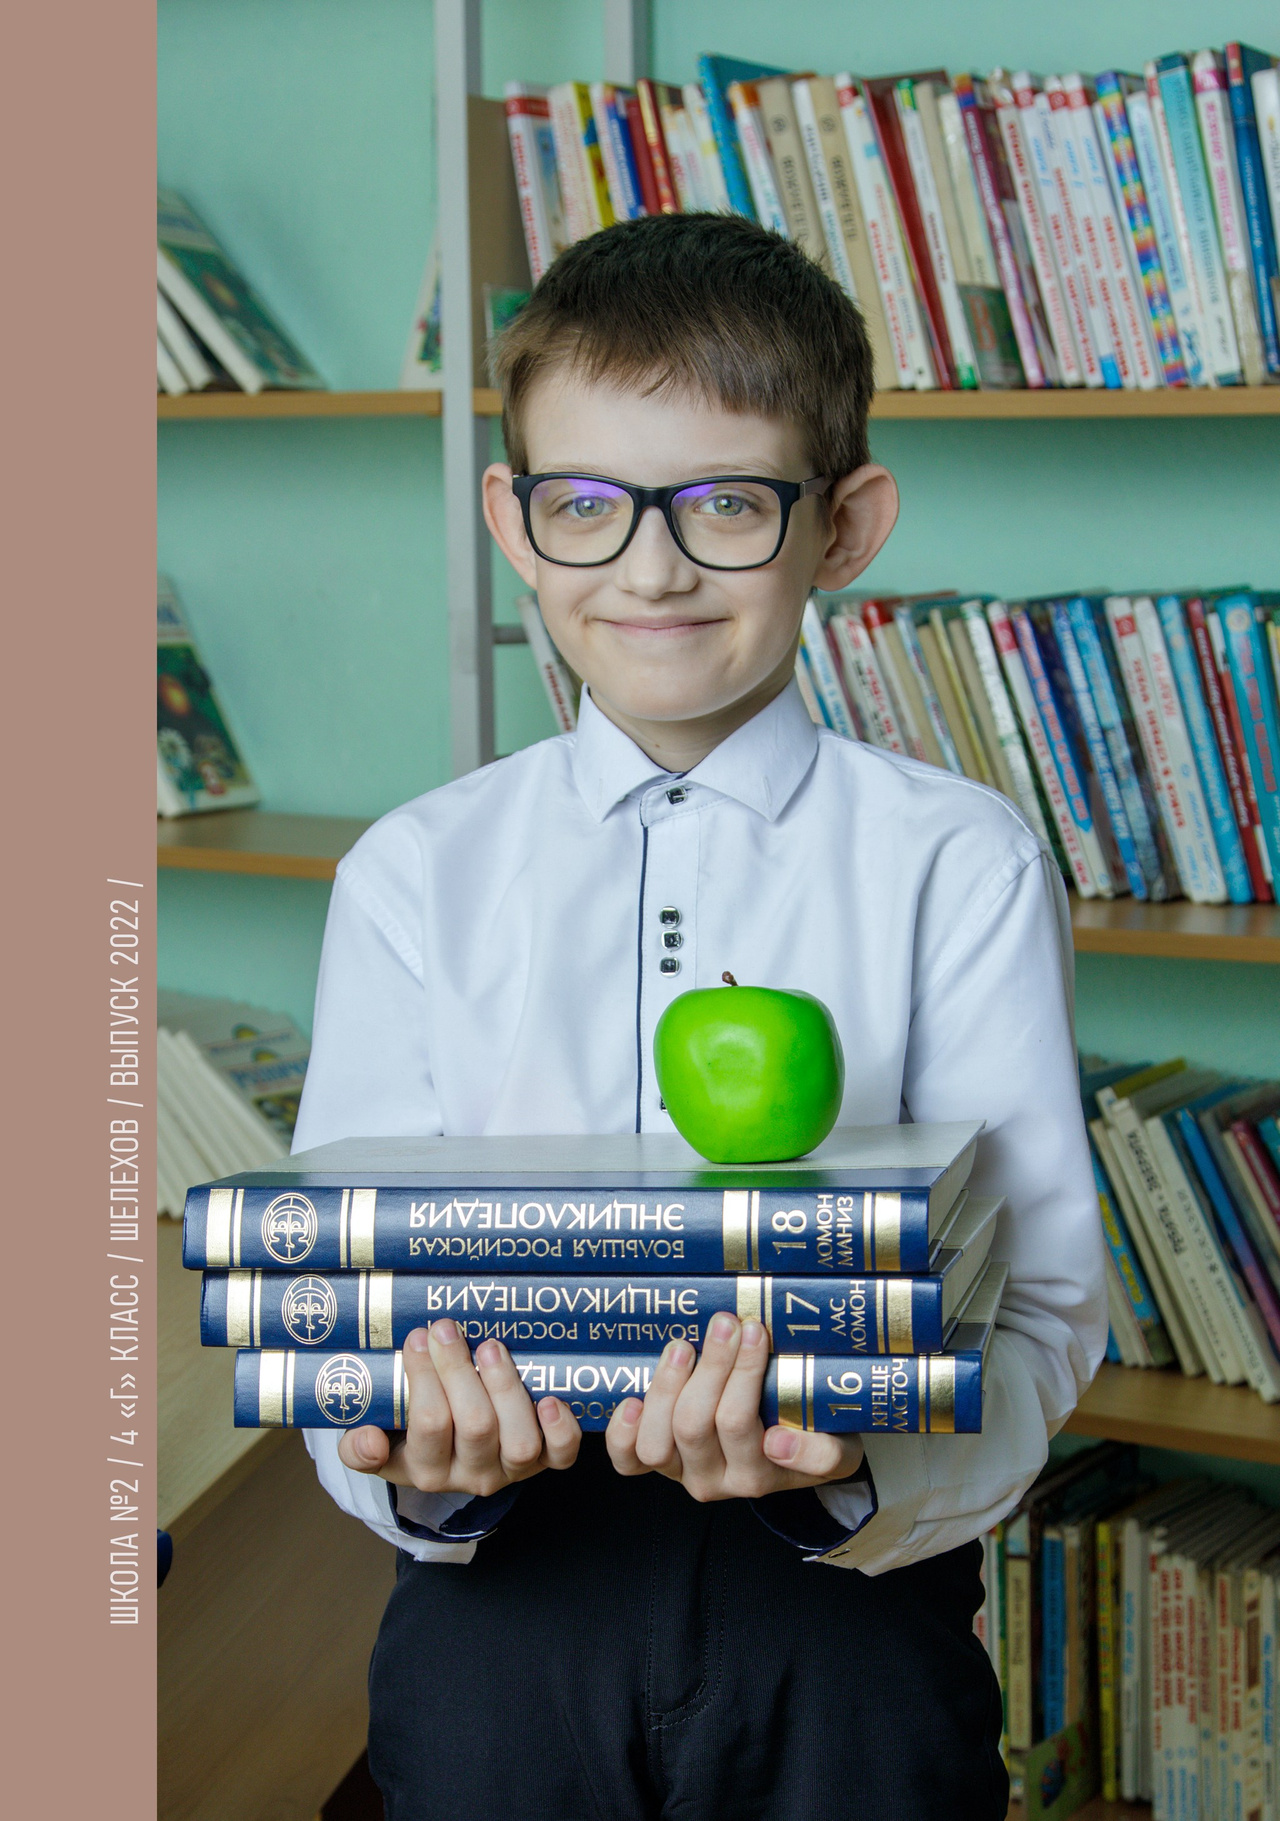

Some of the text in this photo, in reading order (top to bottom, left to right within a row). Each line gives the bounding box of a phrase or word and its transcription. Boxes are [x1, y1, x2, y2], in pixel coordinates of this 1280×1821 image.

[409, 1197, 685, 1231] ЭНЦИКЛОПЕДИЯ
[771, 1208, 808, 1256] 18
[815, 1193, 834, 1269] ЛОМОН
[836, 1195, 854, 1268] МАНИЗ
[409, 1236, 685, 1261] БОЛЬШАЯ РОССИЙСКАЯ
[426, 1280, 700, 1316] ЭНЦИКЛОПЕДИЯ
[785, 1291, 822, 1337] 17
[829, 1297, 847, 1337] ЛАС
[848, 1279, 867, 1353] ЛОМОН
[588, 1321, 700, 1342] БОЛЬШАЯ
[827, 1370, 863, 1417] 16
[871, 1364, 889, 1427] КРЕЩЕ
[891, 1357, 909, 1433] ЛАСТОЧ
